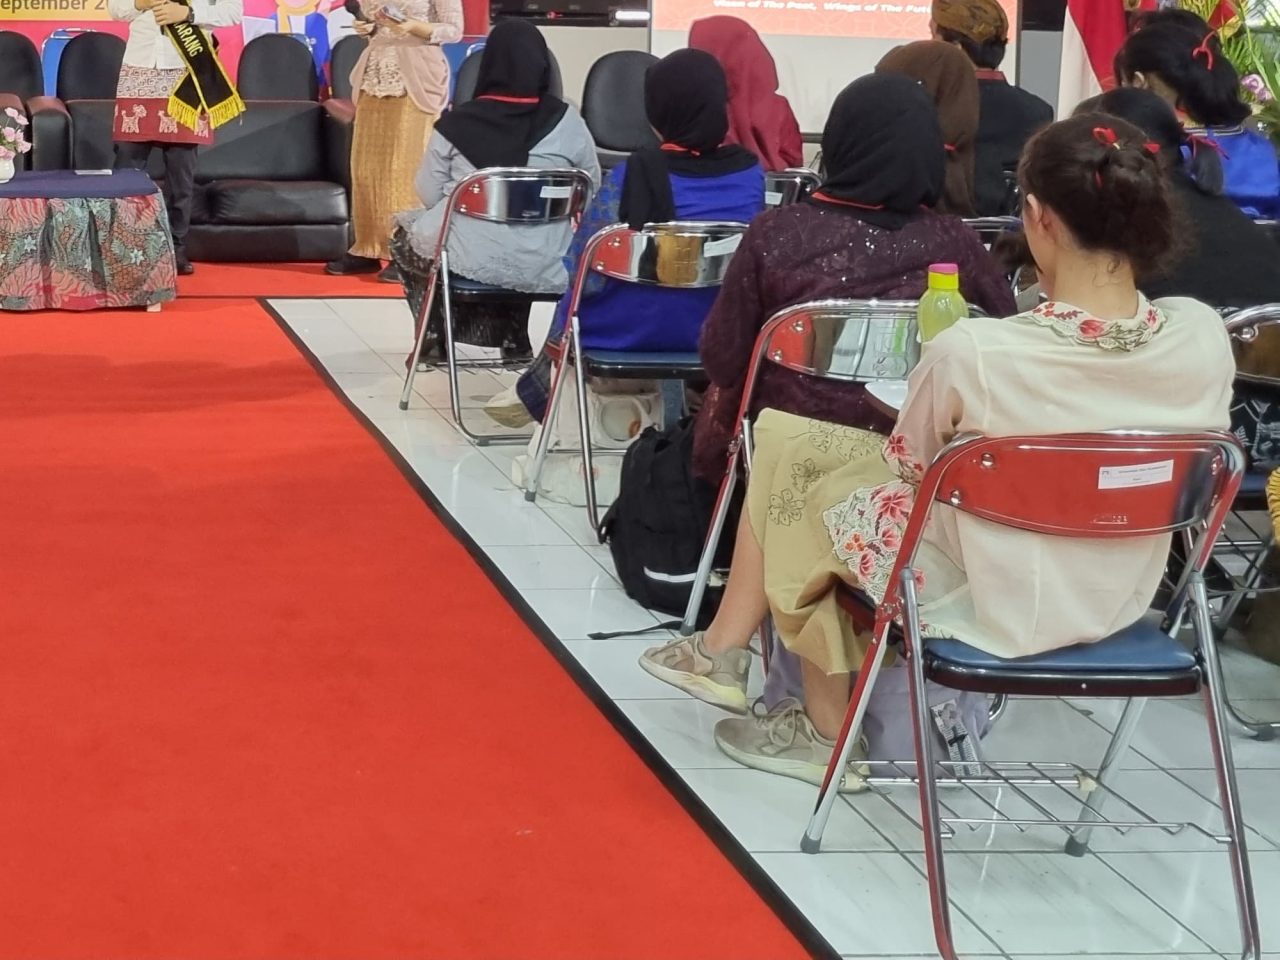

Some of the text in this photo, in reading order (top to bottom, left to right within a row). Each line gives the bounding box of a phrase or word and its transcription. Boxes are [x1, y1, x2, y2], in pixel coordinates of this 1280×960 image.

[747, 0, 762, 8] of
[763, 0, 785, 9] The
[823, 2, 862, 12] Wings
[864, 3, 879, 12] of
[880, 4, 902, 12] The
[173, 22, 204, 58] ARANG
